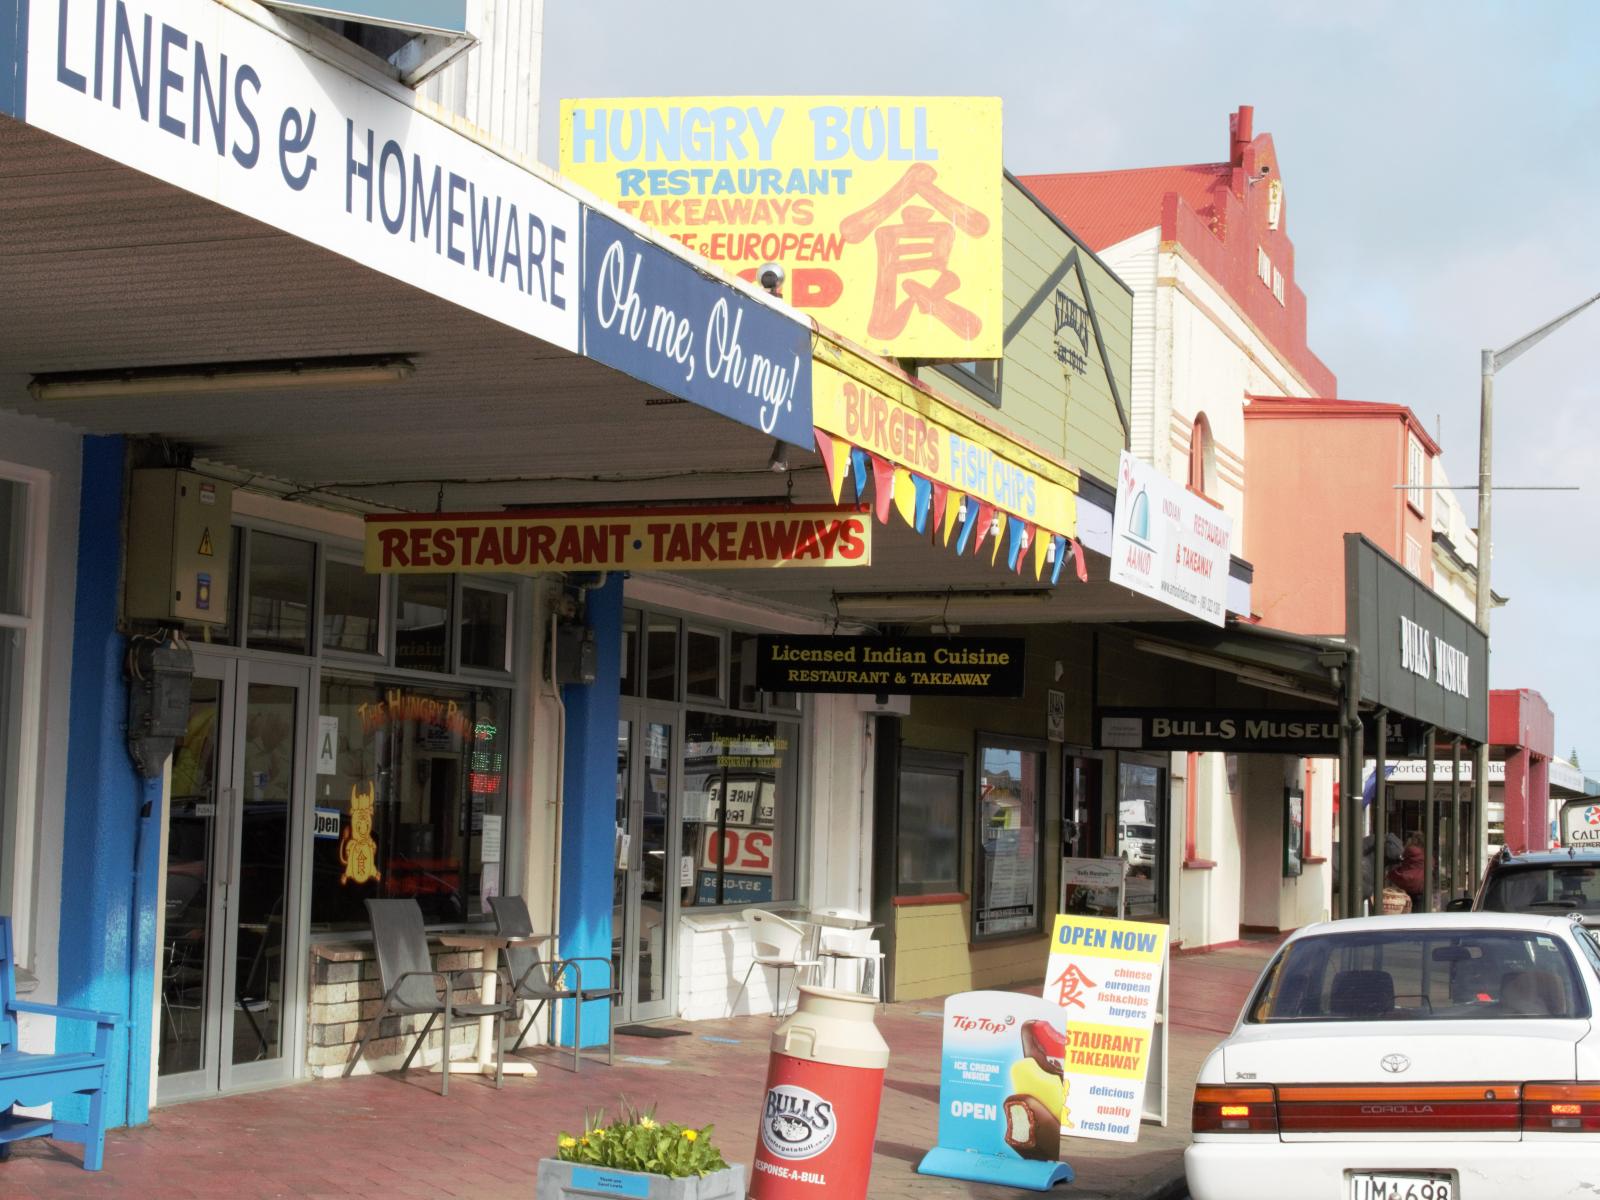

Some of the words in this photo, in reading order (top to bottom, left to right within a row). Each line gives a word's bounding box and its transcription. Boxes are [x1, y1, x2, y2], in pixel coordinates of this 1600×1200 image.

[572, 107, 784, 163] HUNGRY
[809, 107, 939, 161] BULL
[56, 0, 261, 169] LINENS
[345, 118, 566, 311] HOMEWARE
[616, 169, 852, 196] RESTAURANT
[618, 199, 814, 226] TAKEAWAYS
[710, 232, 846, 262] EUROPEAN
[839, 162, 990, 340] 食
[597, 240, 646, 342] Oh
[647, 305, 694, 381] me,
[706, 297, 747, 388] Oh
[747, 354, 800, 433] my!
[843, 381, 939, 473] BURGERS
[378, 520, 630, 567] RESTAURANT
[648, 518, 866, 563] TAKEAWAYS
[1194, 513, 1230, 550] RESTAURANT
[1183, 546, 1213, 578] TAKEAWAY
[771, 645, 856, 662] Licensed
[863, 647, 926, 664] Indian
[934, 648, 1009, 665] Cuisine
[1401, 614, 1430, 680] BULLS
[1434, 635, 1469, 698] MUSEUM
[788, 669, 889, 683] RESTAURANT
[894, 671, 906, 684] &
[911, 672, 991, 686] TAKEAWAY
[1152, 718, 1236, 739] BULLS
[1244, 719, 1339, 739] MUSEU
[320, 732, 333, 759] A
[1433, 763, 1471, 773] Frech
[1059, 924, 1107, 949] OPEN
[1110, 930, 1157, 953] NOW
[1114, 968, 1152, 980] chinese
[1051, 963, 1097, 1009] 食
[1104, 980, 1151, 993] european
[1097, 992, 1149, 1007] fish&chips
[1108, 1006, 1147, 1019] burgers
[952, 1015, 977, 1031] Tip
[978, 1018, 1007, 1034] Top
[954, 1061, 968, 1071] ICE
[969, 1062, 1000, 1074] CREAM
[1070, 1050, 1140, 1071] TAKEAWAY
[962, 1070, 991, 1082] INSIDE
[1089, 1085, 1135, 1100] delicious
[765, 1088, 831, 1131] BULLS
[951, 1100, 997, 1121] OPEN
[1097, 1105, 1131, 1118] quality
[1360, 1105, 1434, 1114] COROLLA
[1080, 1120, 1106, 1132] fresh
[1107, 1122, 1130, 1135] food
[756, 1161, 826, 1186] RESPONSE-A-BULL
